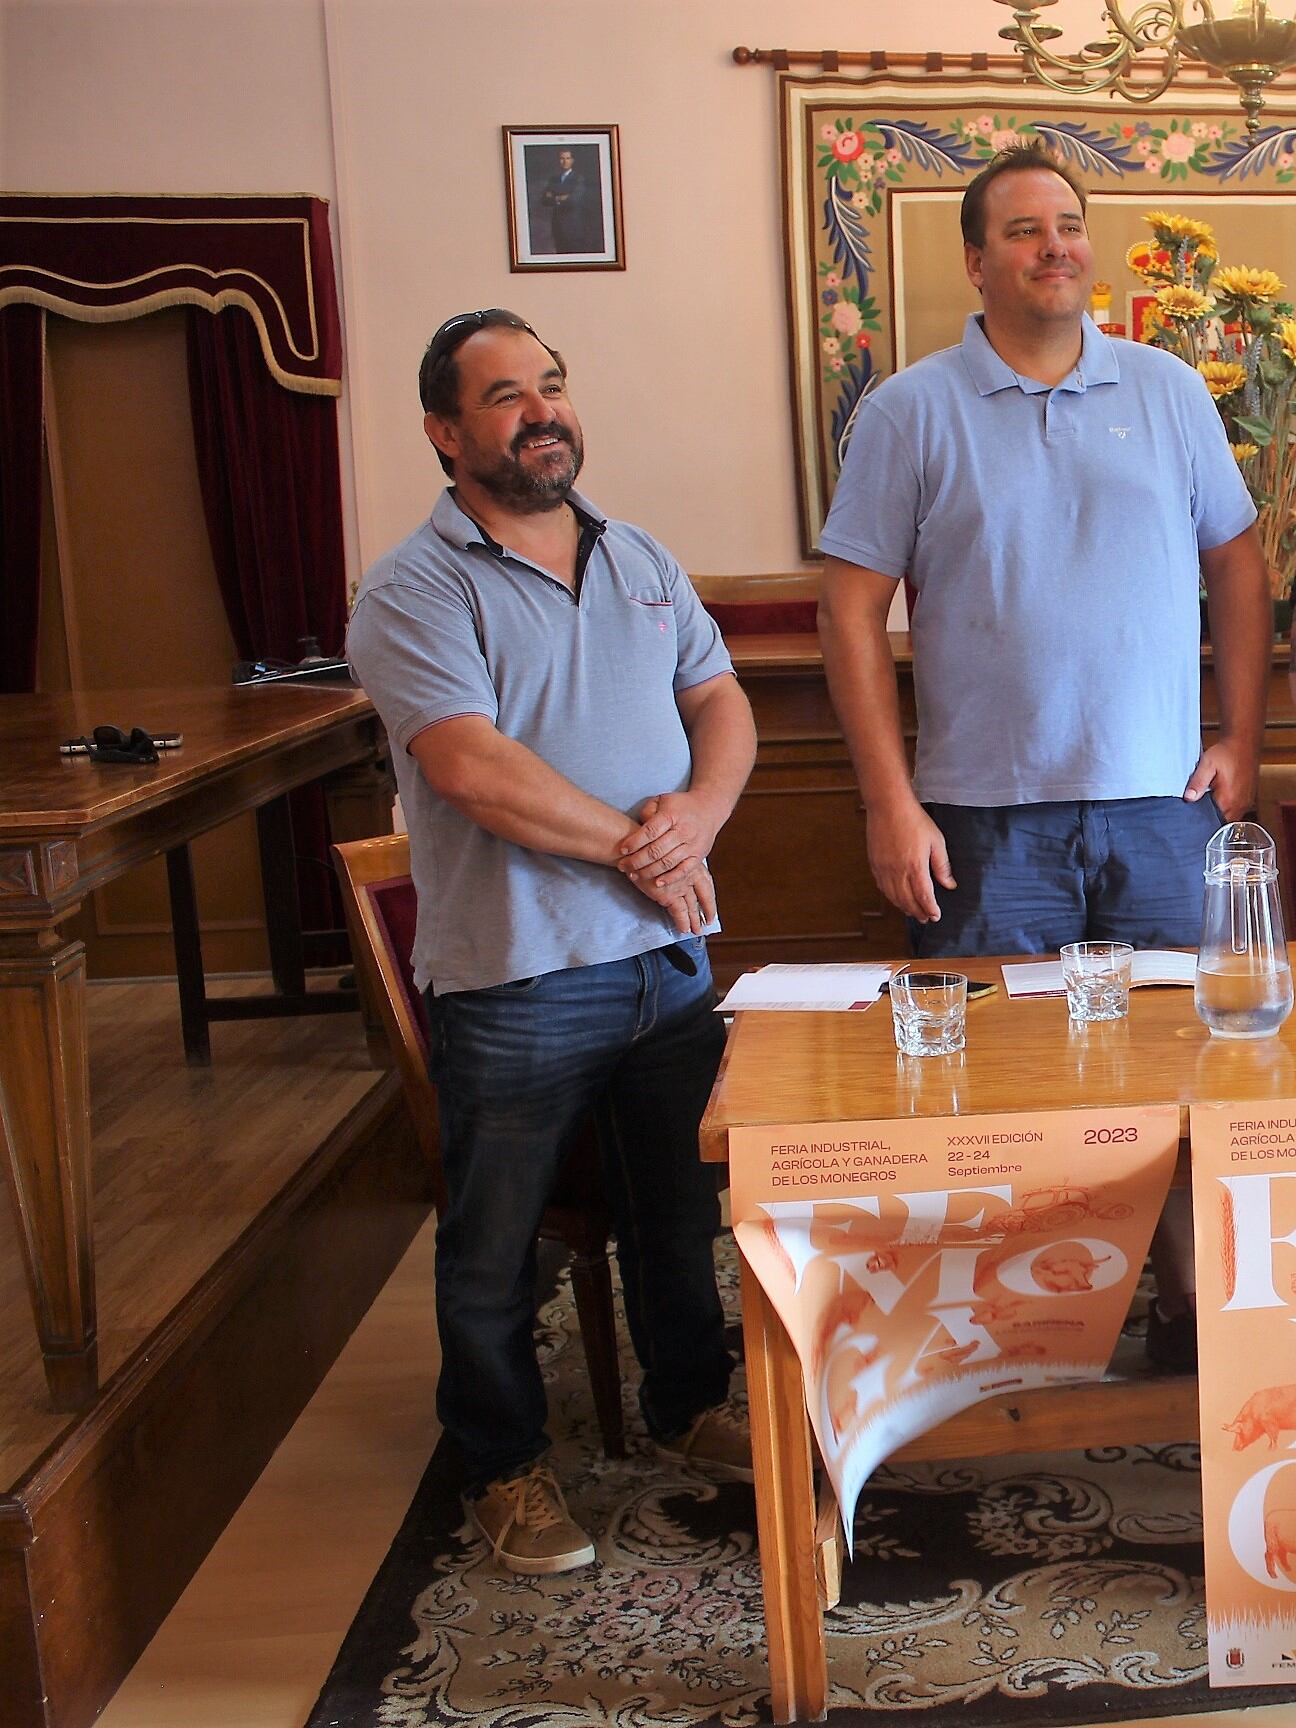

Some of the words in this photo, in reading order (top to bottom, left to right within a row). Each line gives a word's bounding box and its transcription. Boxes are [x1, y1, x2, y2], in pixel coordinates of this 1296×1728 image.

[1229, 1121, 1266, 1132] FERIA
[947, 1135, 990, 1146] XXXVII
[992, 1130, 1043, 1144] EDICIÓN
[1083, 1127, 1138, 1145] 2023
[1230, 1133, 1295, 1146] AGRÍCOLA
[771, 1144, 808, 1155] FERIA
[810, 1140, 891, 1153] INDUSTRIAL,
[1231, 1151, 1247, 1161] DE
[1250, 1149, 1274, 1160] LOS
[771, 1157, 839, 1171] AGRÍCOLA
[842, 1157, 850, 1167] Y
[853, 1153, 928, 1167] GANADERA
[772, 1176, 790, 1186] DE
[792, 1174, 818, 1185] LOS
[820, 1170, 897, 1183] MONEGROS
[948, 1164, 1022, 1177] Septiembre
